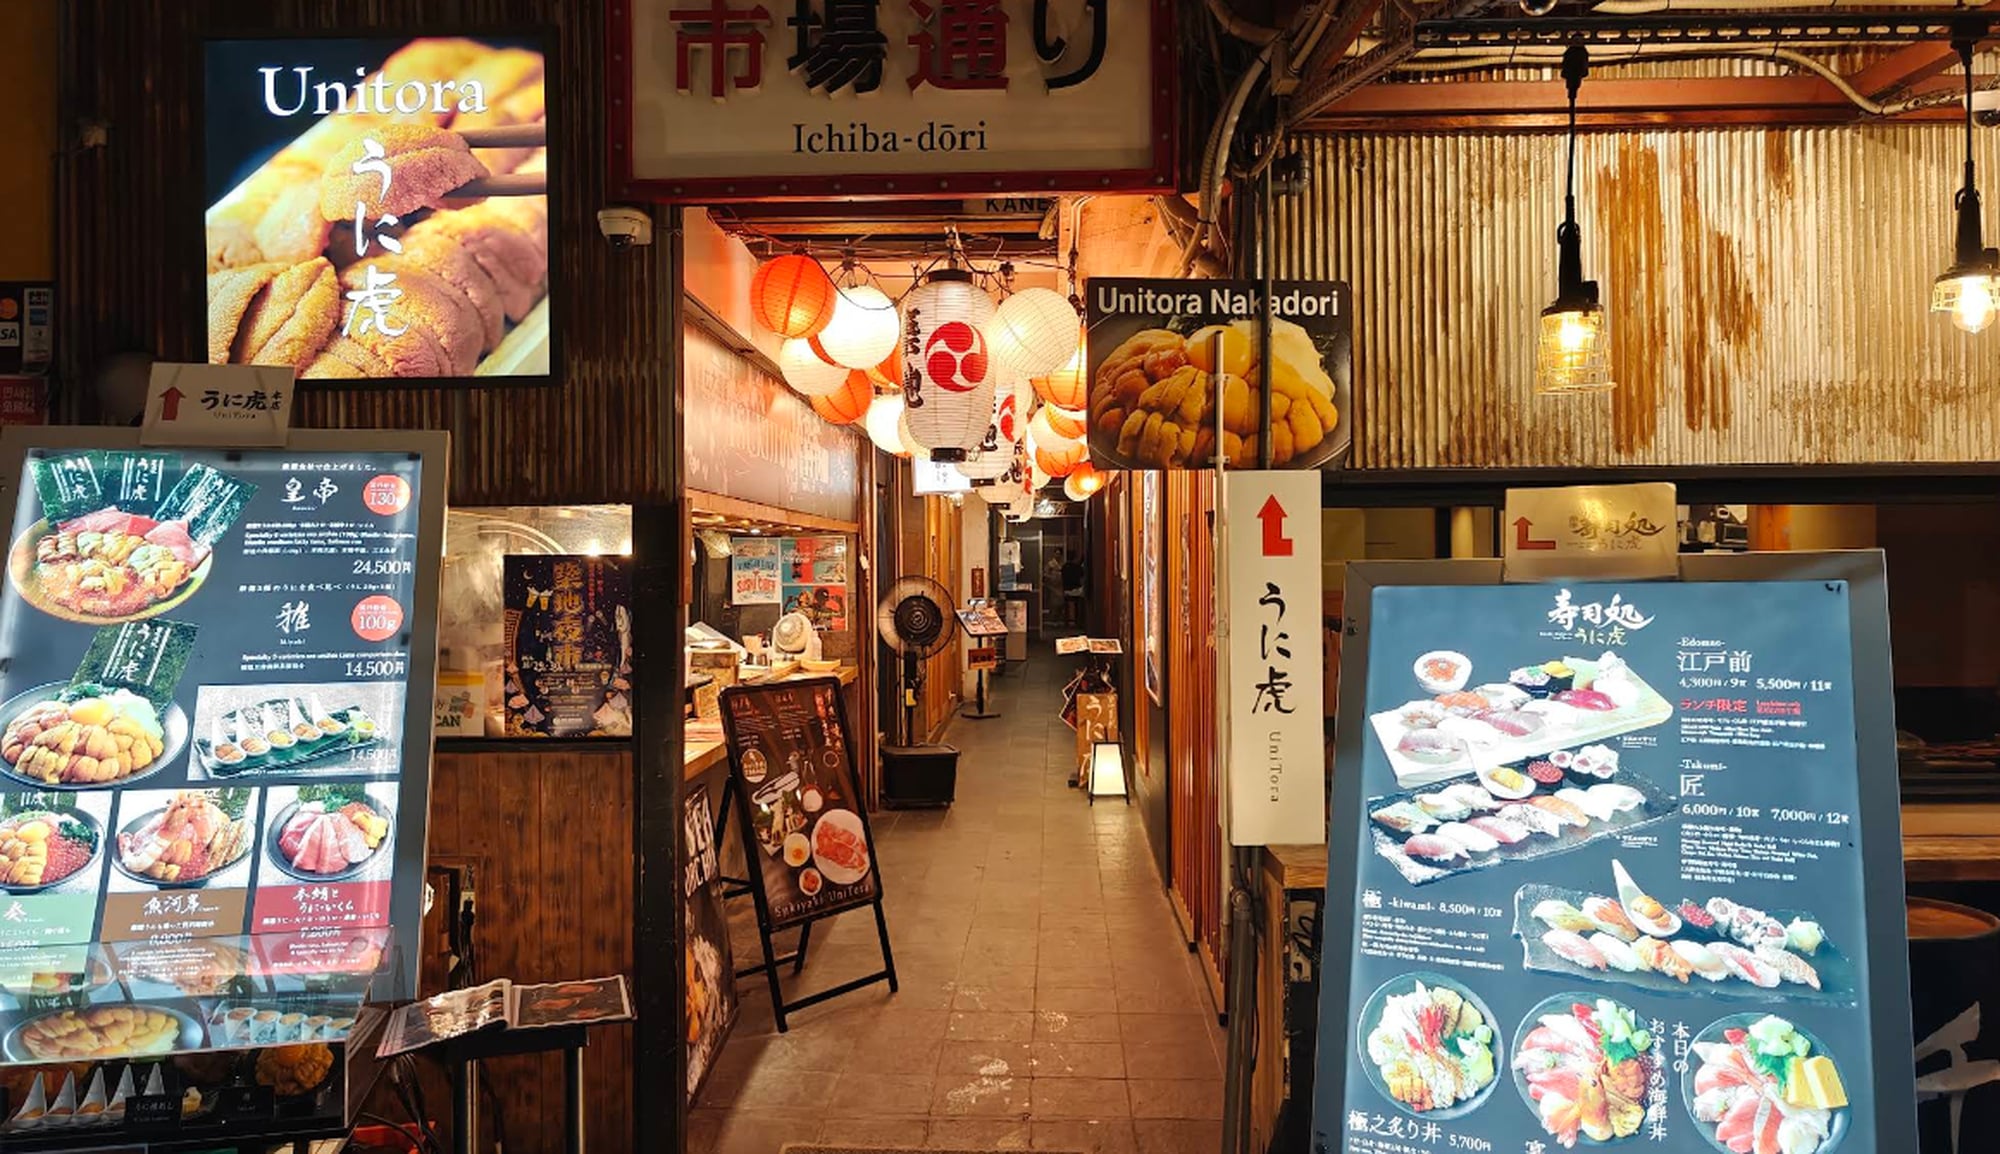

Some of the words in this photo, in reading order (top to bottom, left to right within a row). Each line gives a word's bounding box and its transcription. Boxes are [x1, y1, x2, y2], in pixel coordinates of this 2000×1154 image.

[669, 0, 1108, 97] 市場通り
[258, 66, 487, 117] Unitora
[793, 121, 988, 154] Ichiba-dōri
[342, 138, 409, 337] うに虎
[1098, 287, 1201, 315] Unitora
[201, 390, 268, 411] うに虎
[281, 477, 338, 505] 皇帝
[1548, 588, 1656, 630] 寿司処
[1251, 583, 1296, 714] うに虎
[1676, 650, 1752, 673] 江戸前
[345, 661, 404, 677] 14,500円
[1680, 699, 1747, 712] ランチ限定
[1269, 731, 1283, 803] UniTora
[1680, 774, 1705, 797] 匠
[1672, 1021, 1690, 1074] 本日の
[1449, 1133, 1491, 1152] 5,700円
